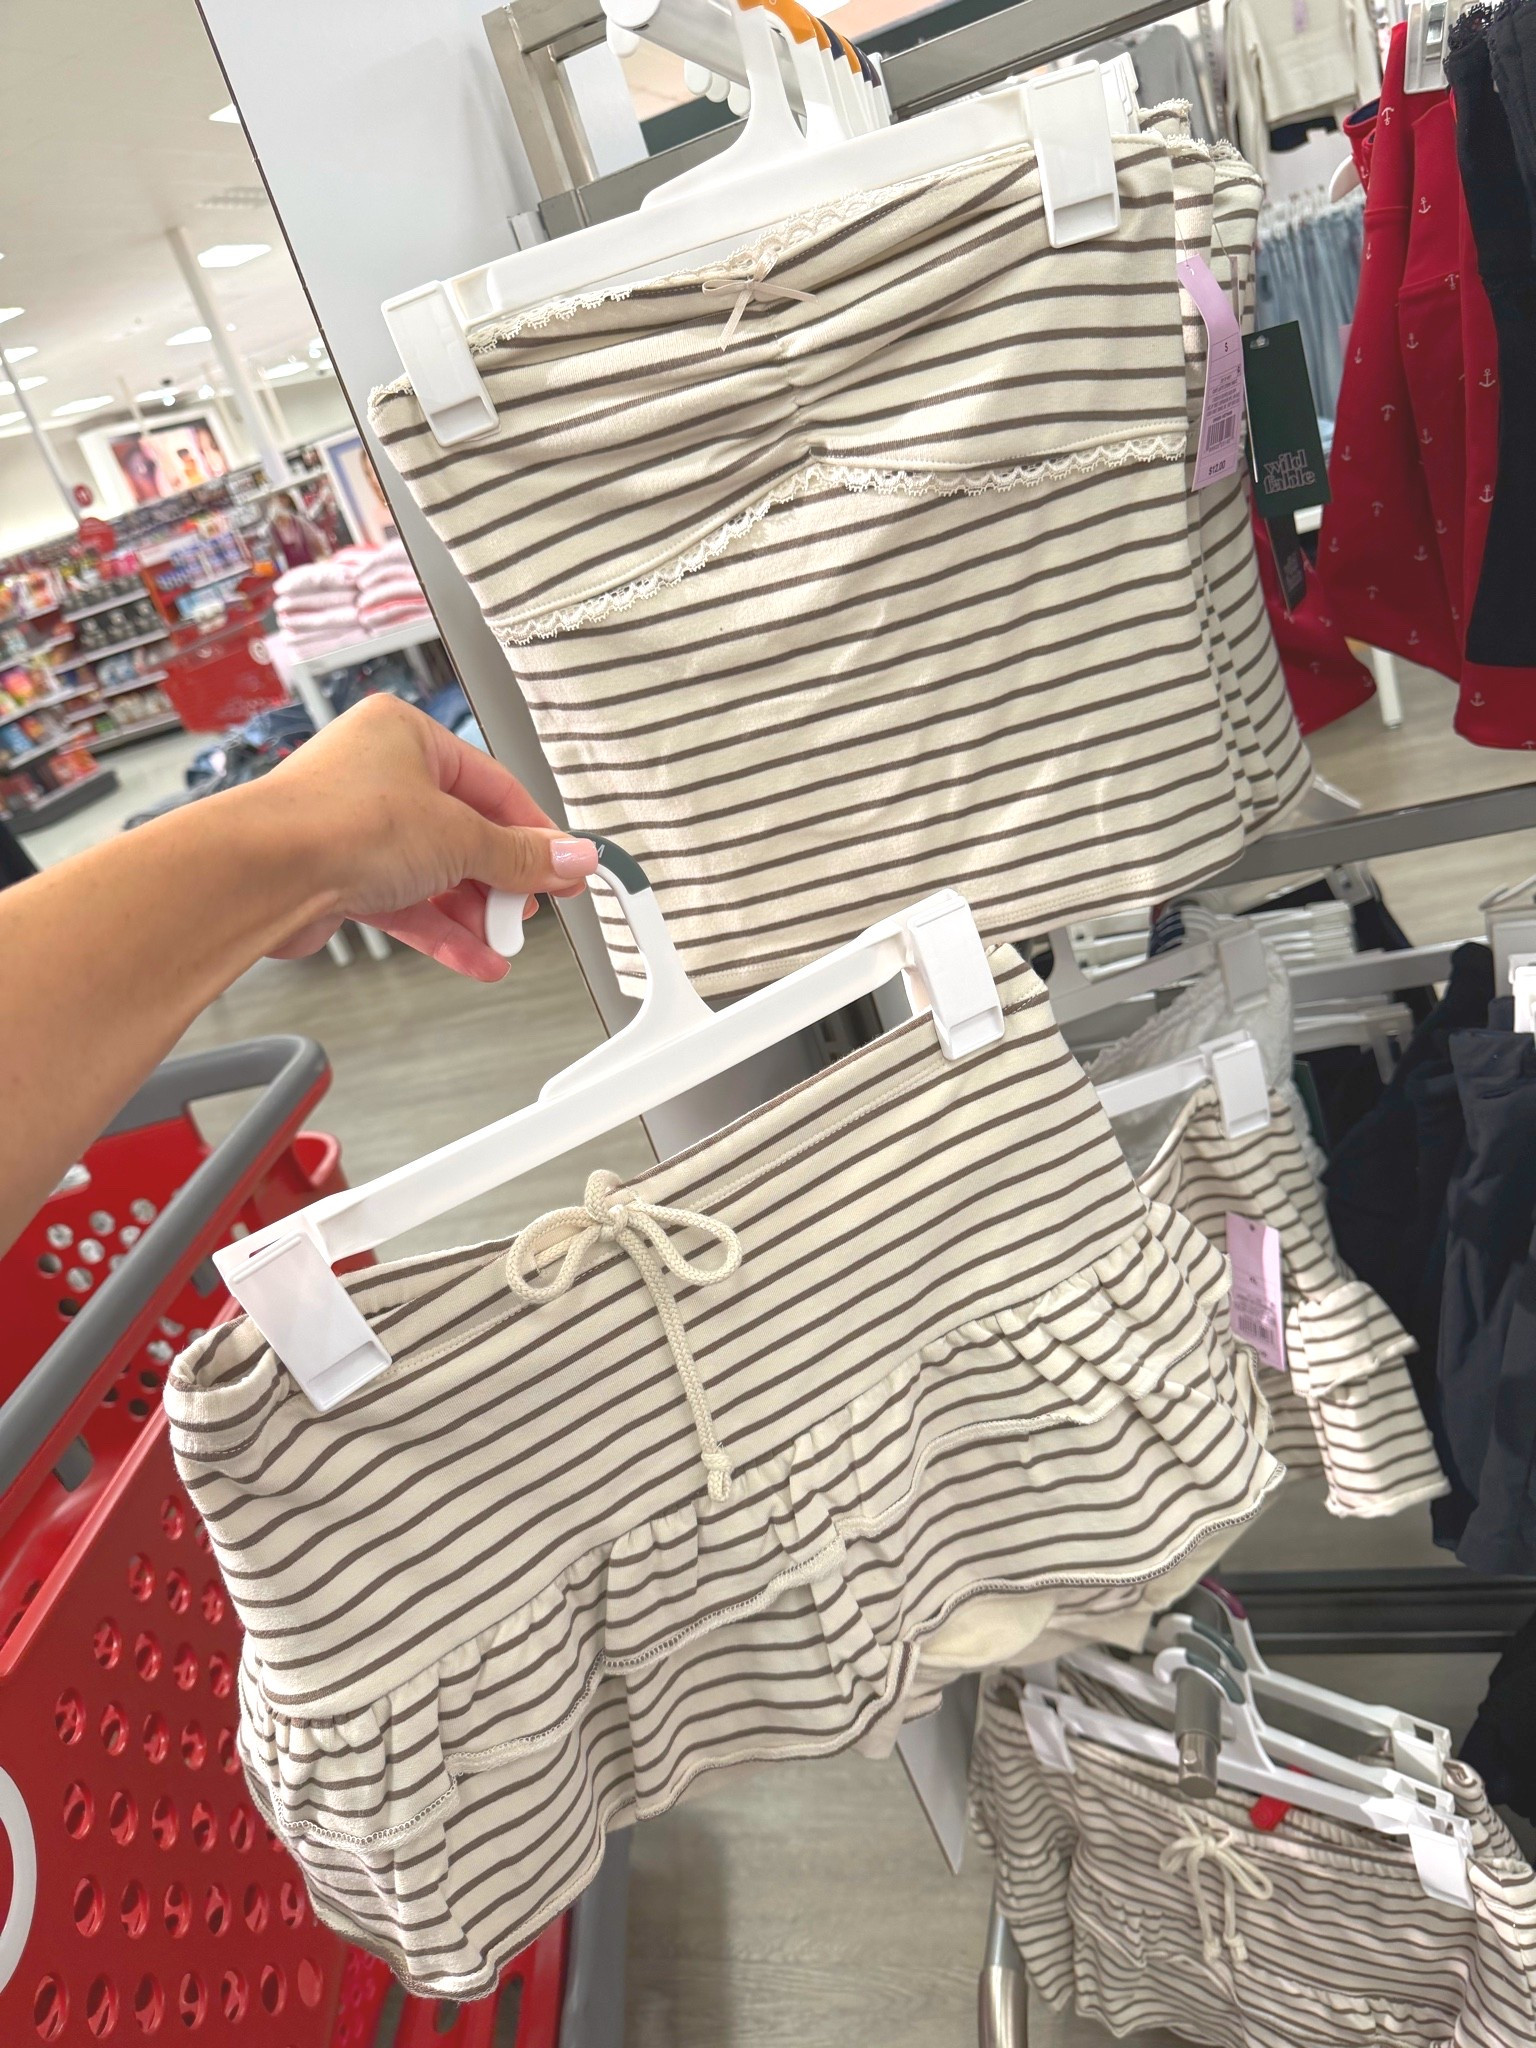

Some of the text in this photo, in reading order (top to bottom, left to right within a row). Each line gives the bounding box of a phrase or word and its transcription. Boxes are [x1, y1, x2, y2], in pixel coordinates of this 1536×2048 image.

[1224, 342, 1229, 352] S
[1208, 459, 1226, 476] $12.00
[1263, 448, 1308, 475] wild
[1263, 467, 1316, 495] fable
